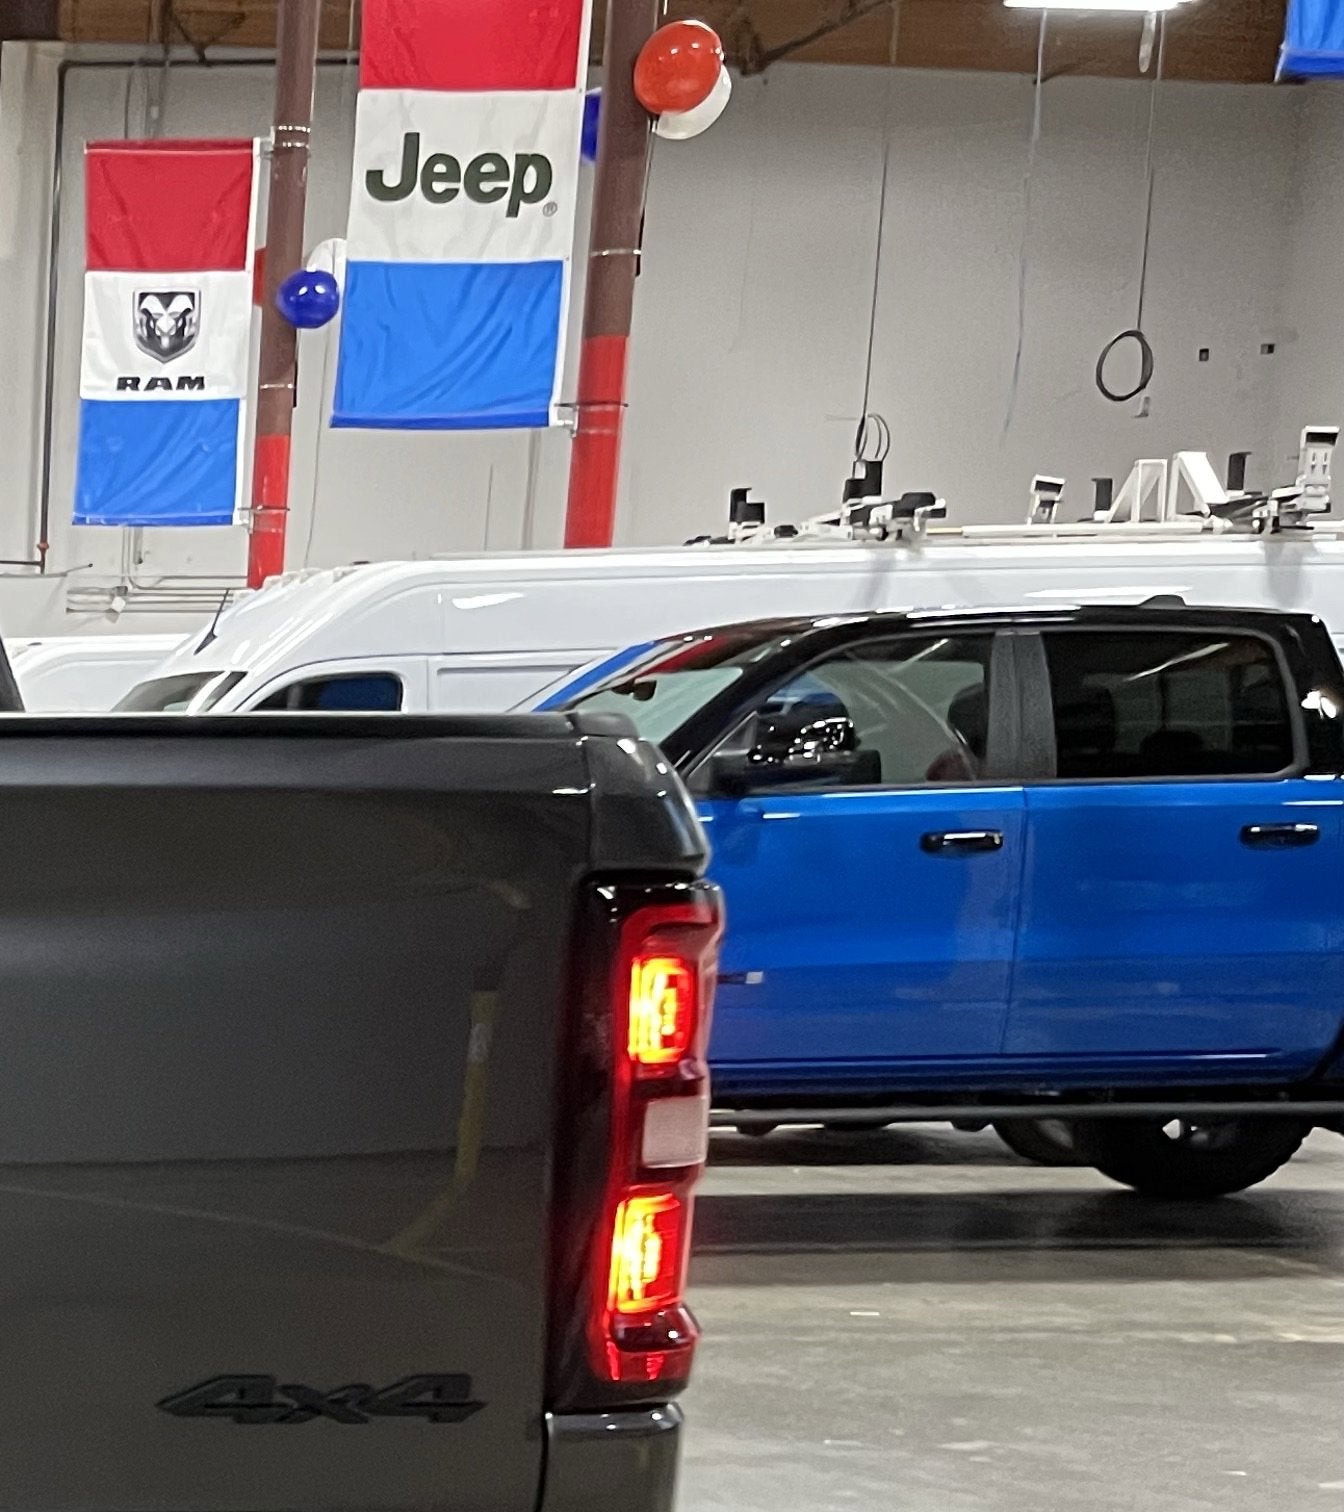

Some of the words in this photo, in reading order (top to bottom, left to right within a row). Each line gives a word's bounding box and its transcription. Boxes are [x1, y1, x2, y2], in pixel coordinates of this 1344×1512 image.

[365, 131, 554, 218] Jeep
[115, 375, 207, 392] RAM
[154, 1372, 489, 1425] 4x4
